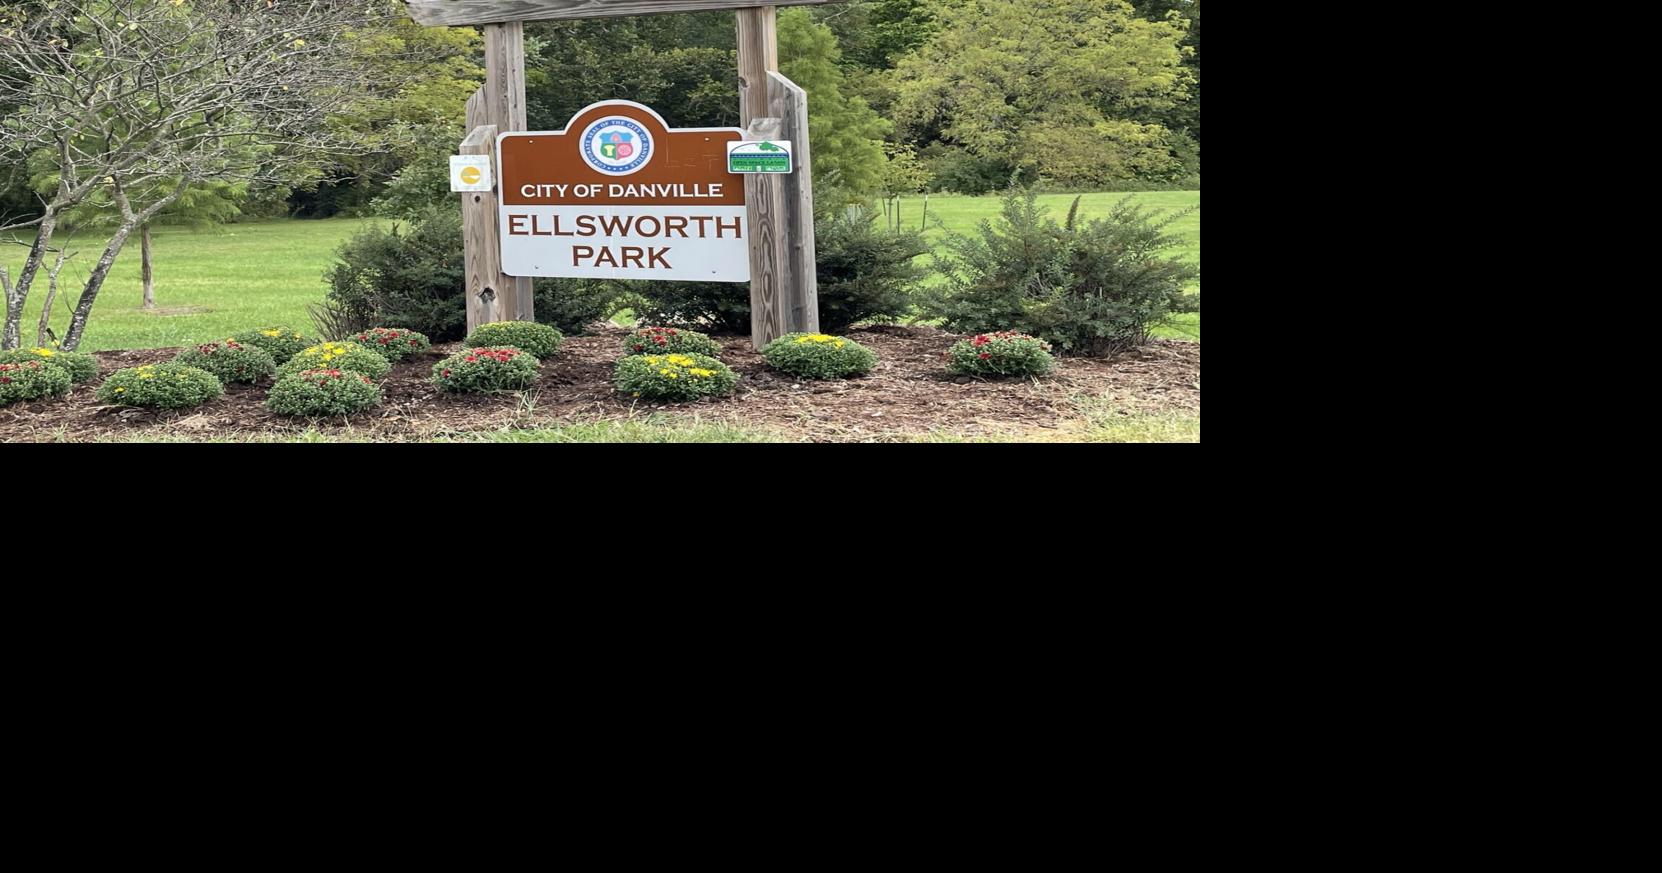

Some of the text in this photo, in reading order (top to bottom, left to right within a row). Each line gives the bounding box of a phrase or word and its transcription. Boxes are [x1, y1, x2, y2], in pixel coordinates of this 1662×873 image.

[587, 127, 600, 139] SEAL
[627, 122, 642, 134] CITY
[640, 133, 648, 142] OF
[630, 142, 649, 168] DANVILLE
[521, 183, 724, 198] CITY OF DANVILLE
[508, 214, 742, 239] ELLSWORTH
[572, 245, 672, 270] PARK
